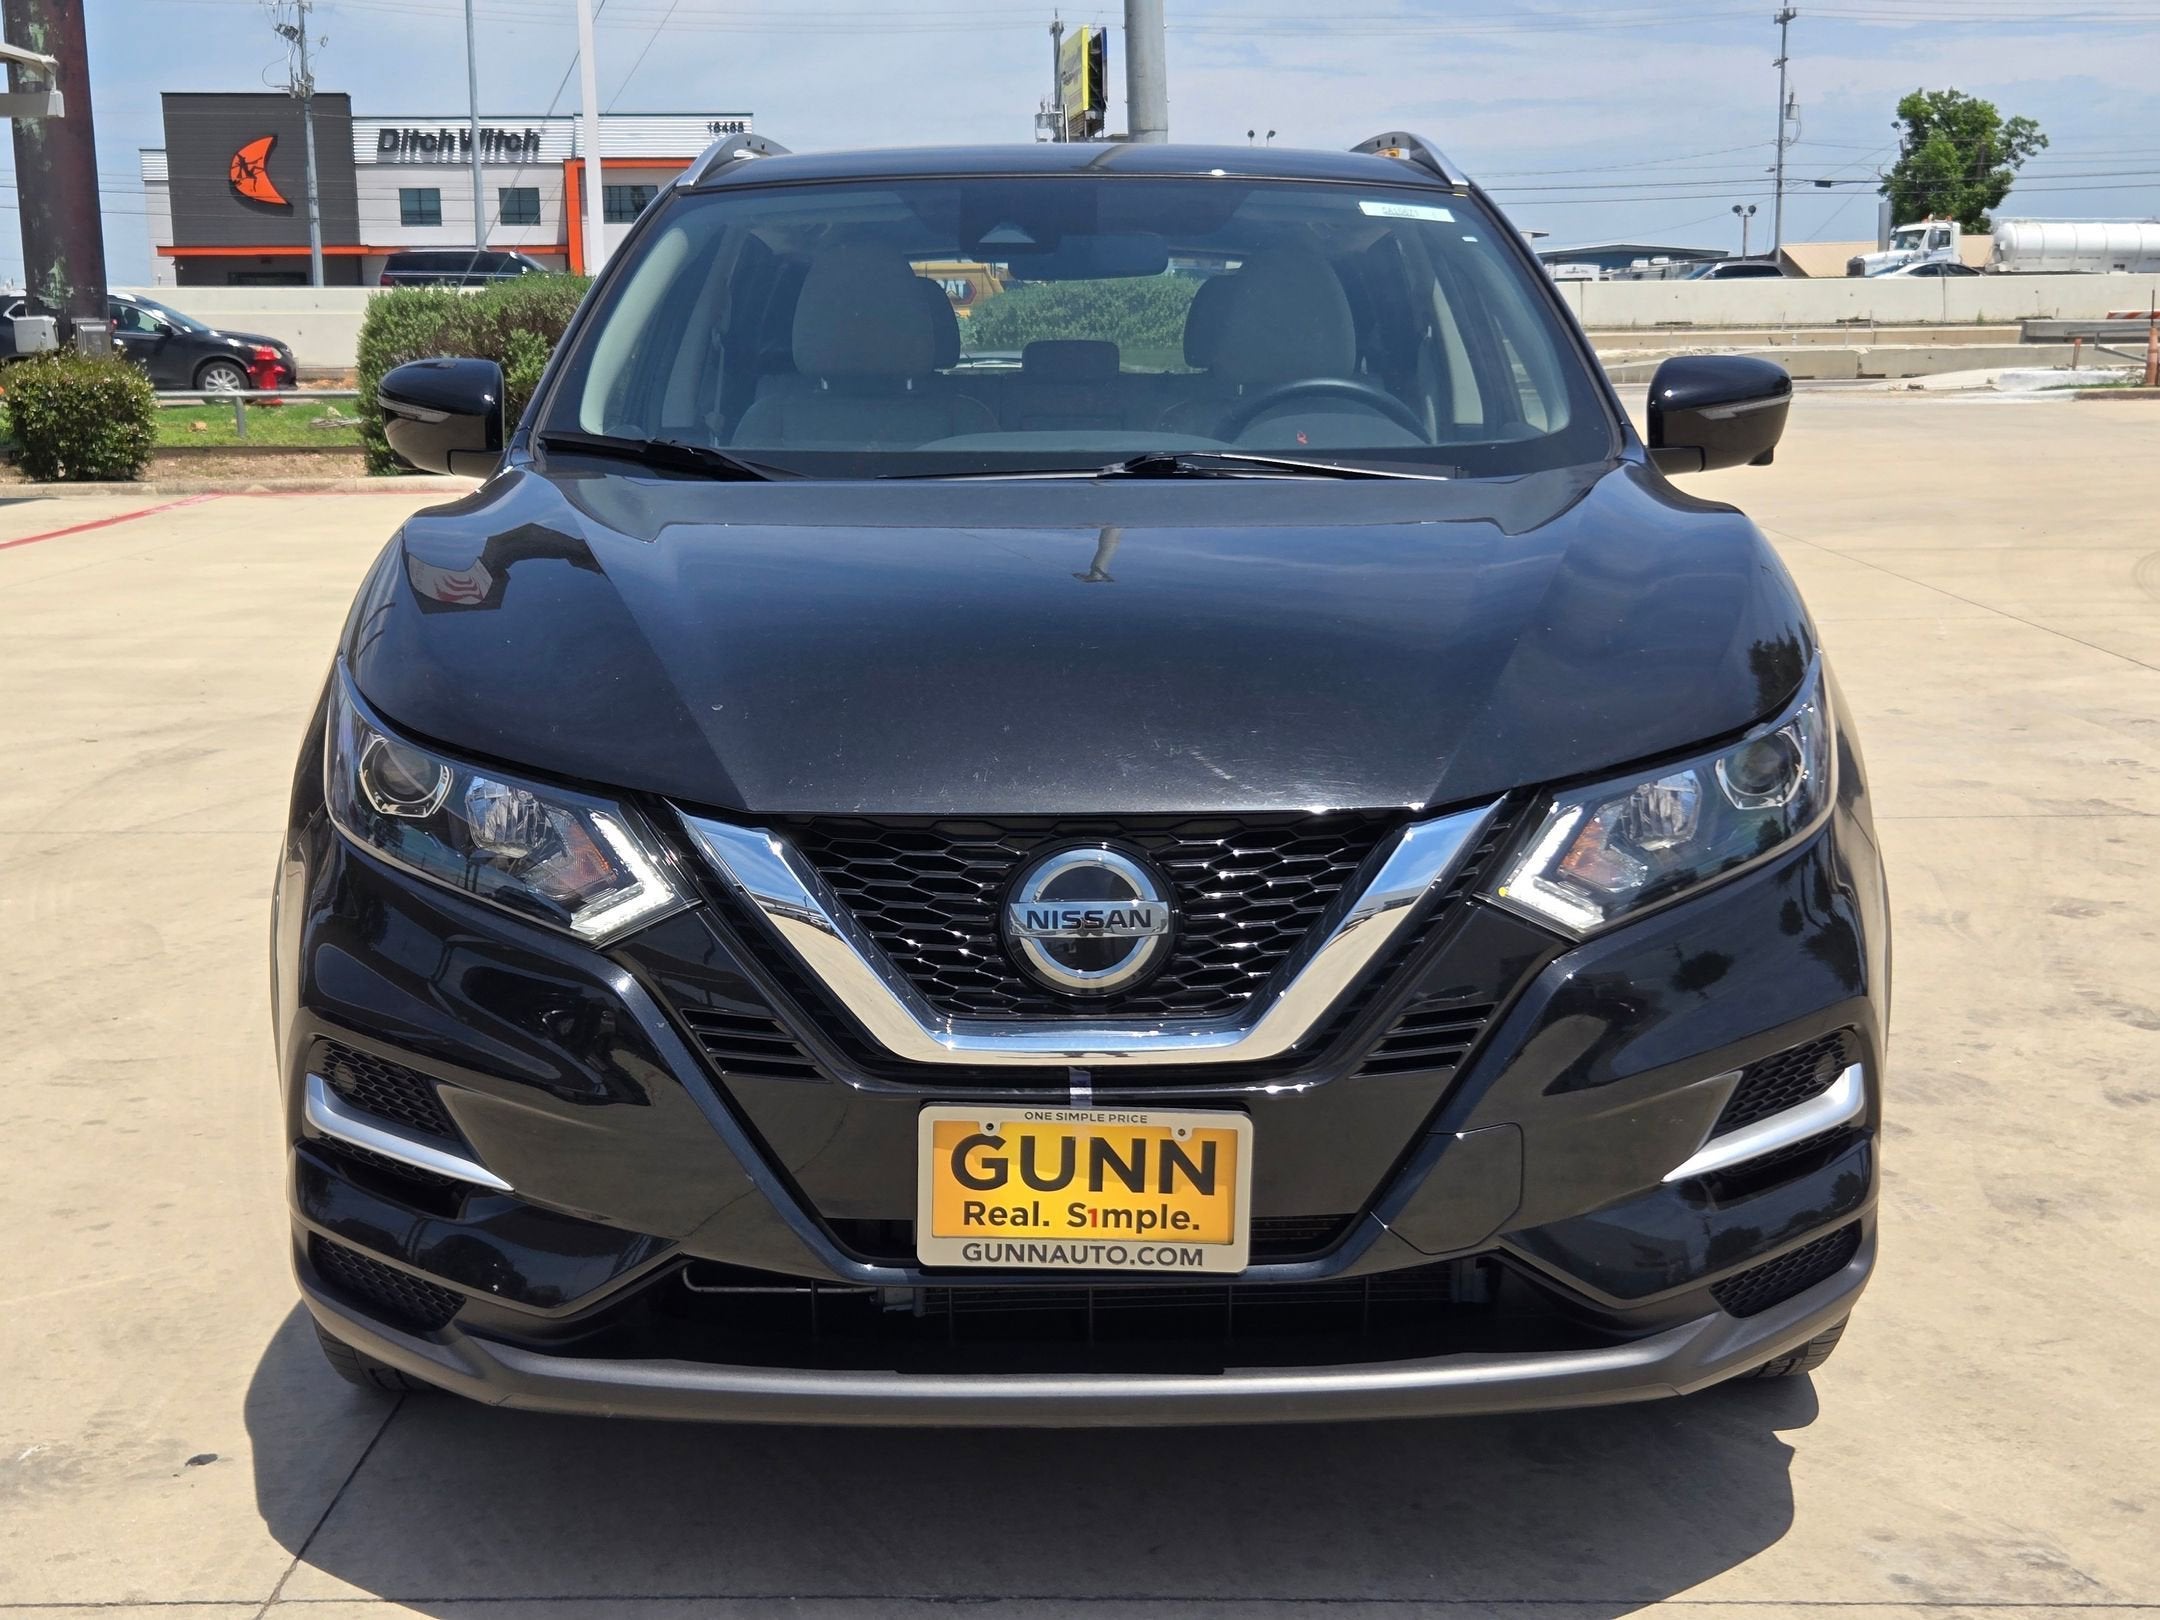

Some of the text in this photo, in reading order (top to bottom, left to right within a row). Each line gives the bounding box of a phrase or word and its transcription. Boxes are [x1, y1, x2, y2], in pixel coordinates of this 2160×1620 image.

[377, 128, 540, 152] Ditch Witch
[1026, 909, 1151, 930] NISSAN
[1024, 1111, 1148, 1124] ONE SIMPLE PRICE
[951, 1133, 1217, 1196] GUNN
[963, 1201, 1050, 1228] Real.
[962, 1242, 1203, 1267] GUNNAUTO.COM
